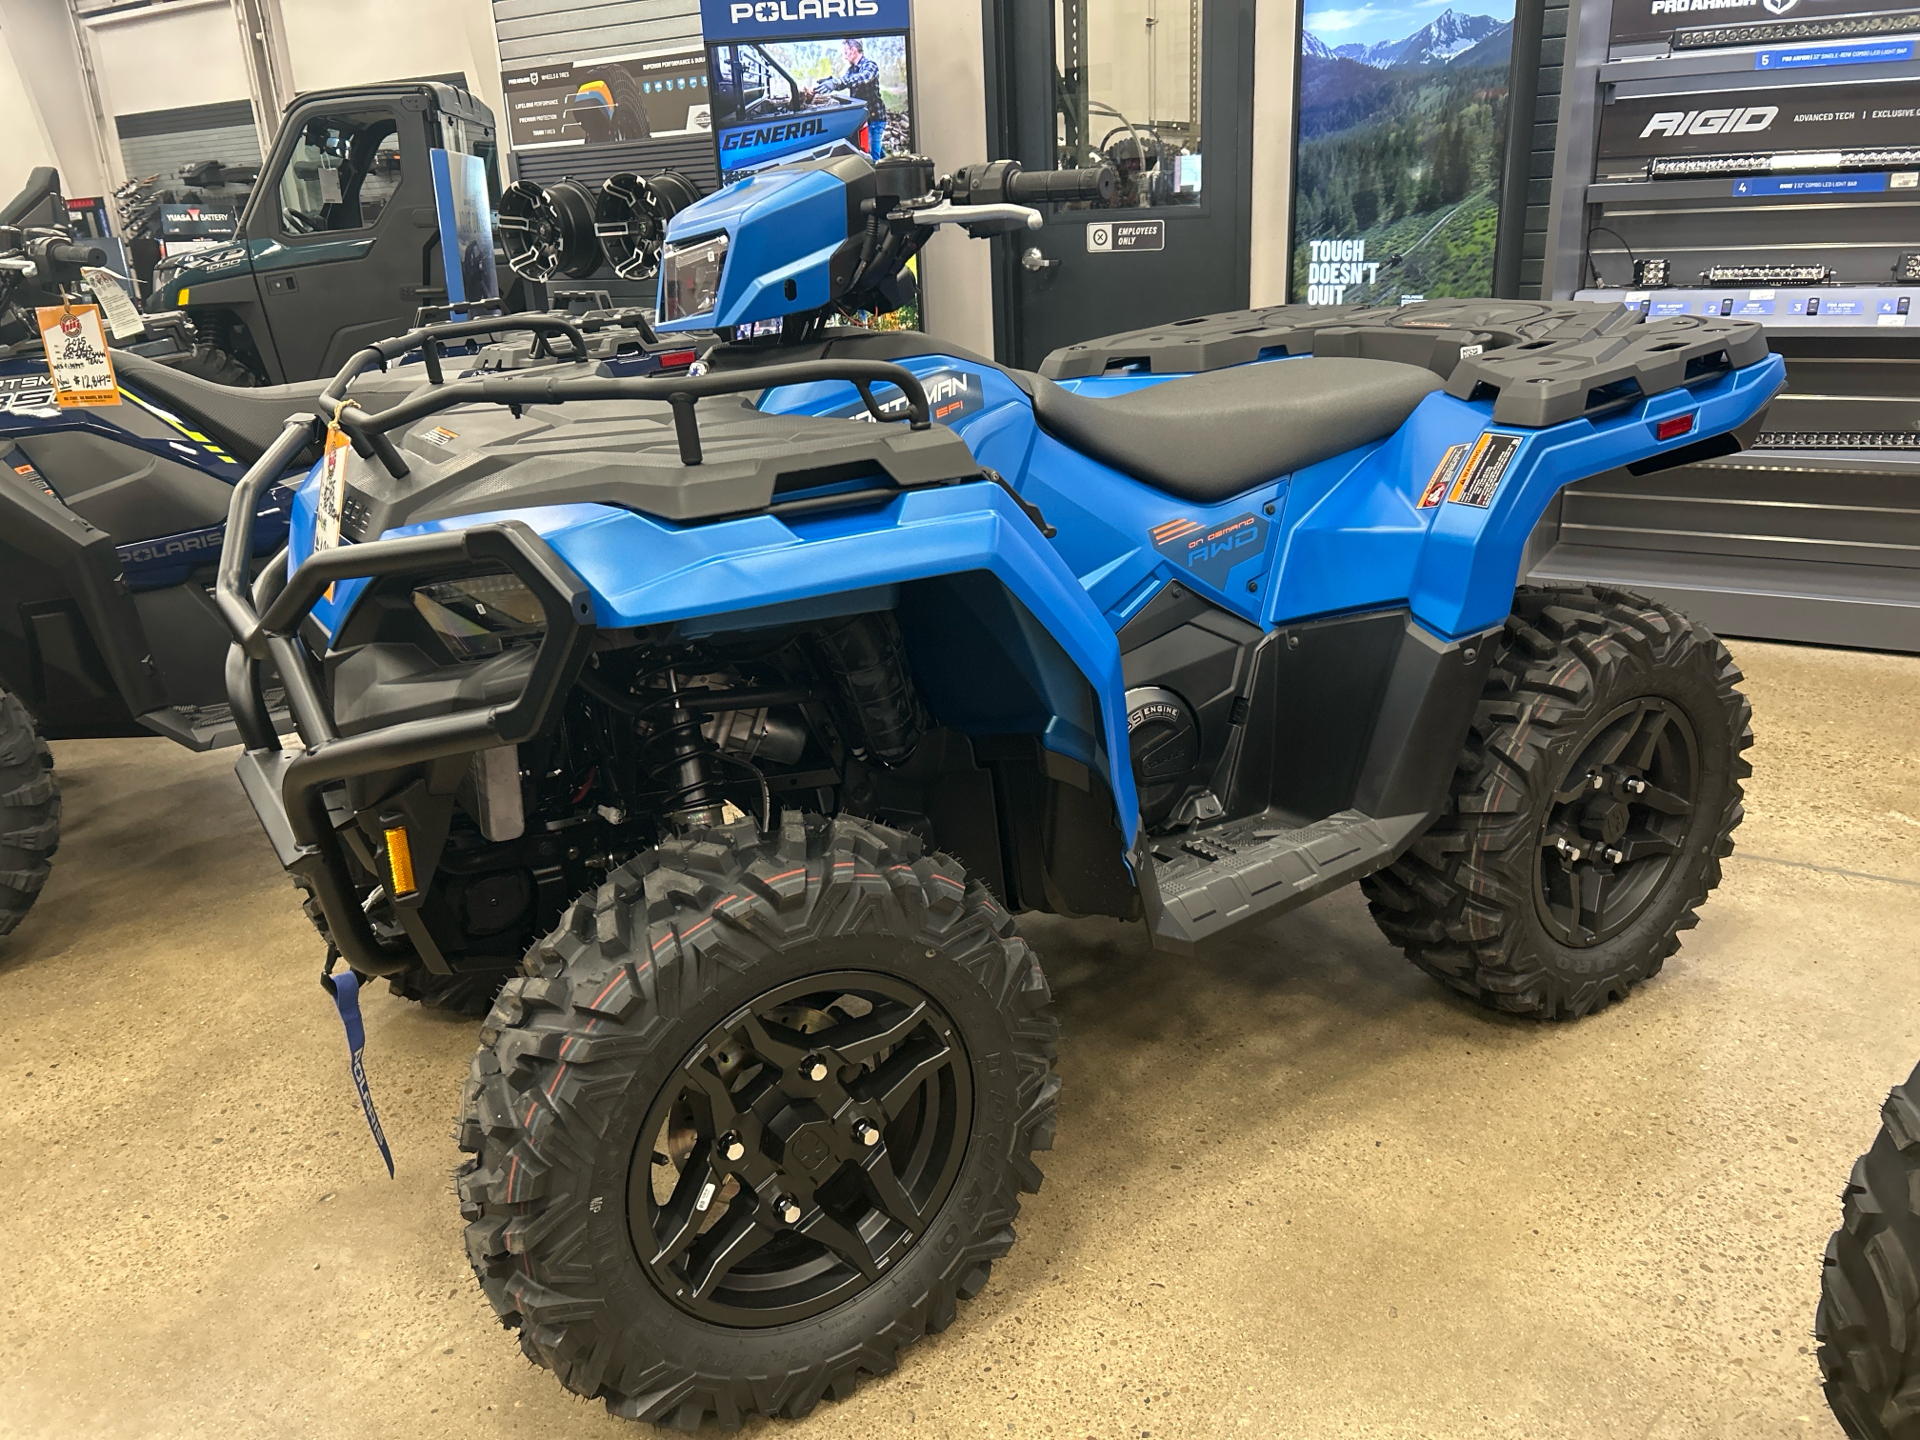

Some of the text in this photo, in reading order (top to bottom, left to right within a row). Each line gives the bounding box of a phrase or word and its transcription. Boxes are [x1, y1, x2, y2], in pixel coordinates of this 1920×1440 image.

[730, 0, 879, 24] POLARIS
[1761, 55, 1770, 66] 5
[1793, 112, 1834, 122] ADVANCED
[1835, 111, 1855, 121] TECH
[1872, 109, 1916, 119] EXCLUSIVE
[1639, 106, 1780, 138] RIGID
[722, 117, 829, 150] GENERAL
[1738, 182, 1747, 193] 4
[166, 214, 229, 222] YUASA BATTERY
[1118, 226, 1158, 236] EMPLOYEES
[1118, 237, 1137, 246] ONLY
[1309, 240, 1366, 262] TOUGH
[1308, 262, 1380, 285] DOESN'T
[1707, 305, 1717, 313] 2
[1793, 303, 1802, 312] 3
[1882, 303, 1892, 312] 4
[936, 400, 964, 419] EFI
[1188, 526, 1258, 567] AWD
[1144, 705, 1179, 717] ENGINE
[353, 1047, 385, 1147] POLARIS
